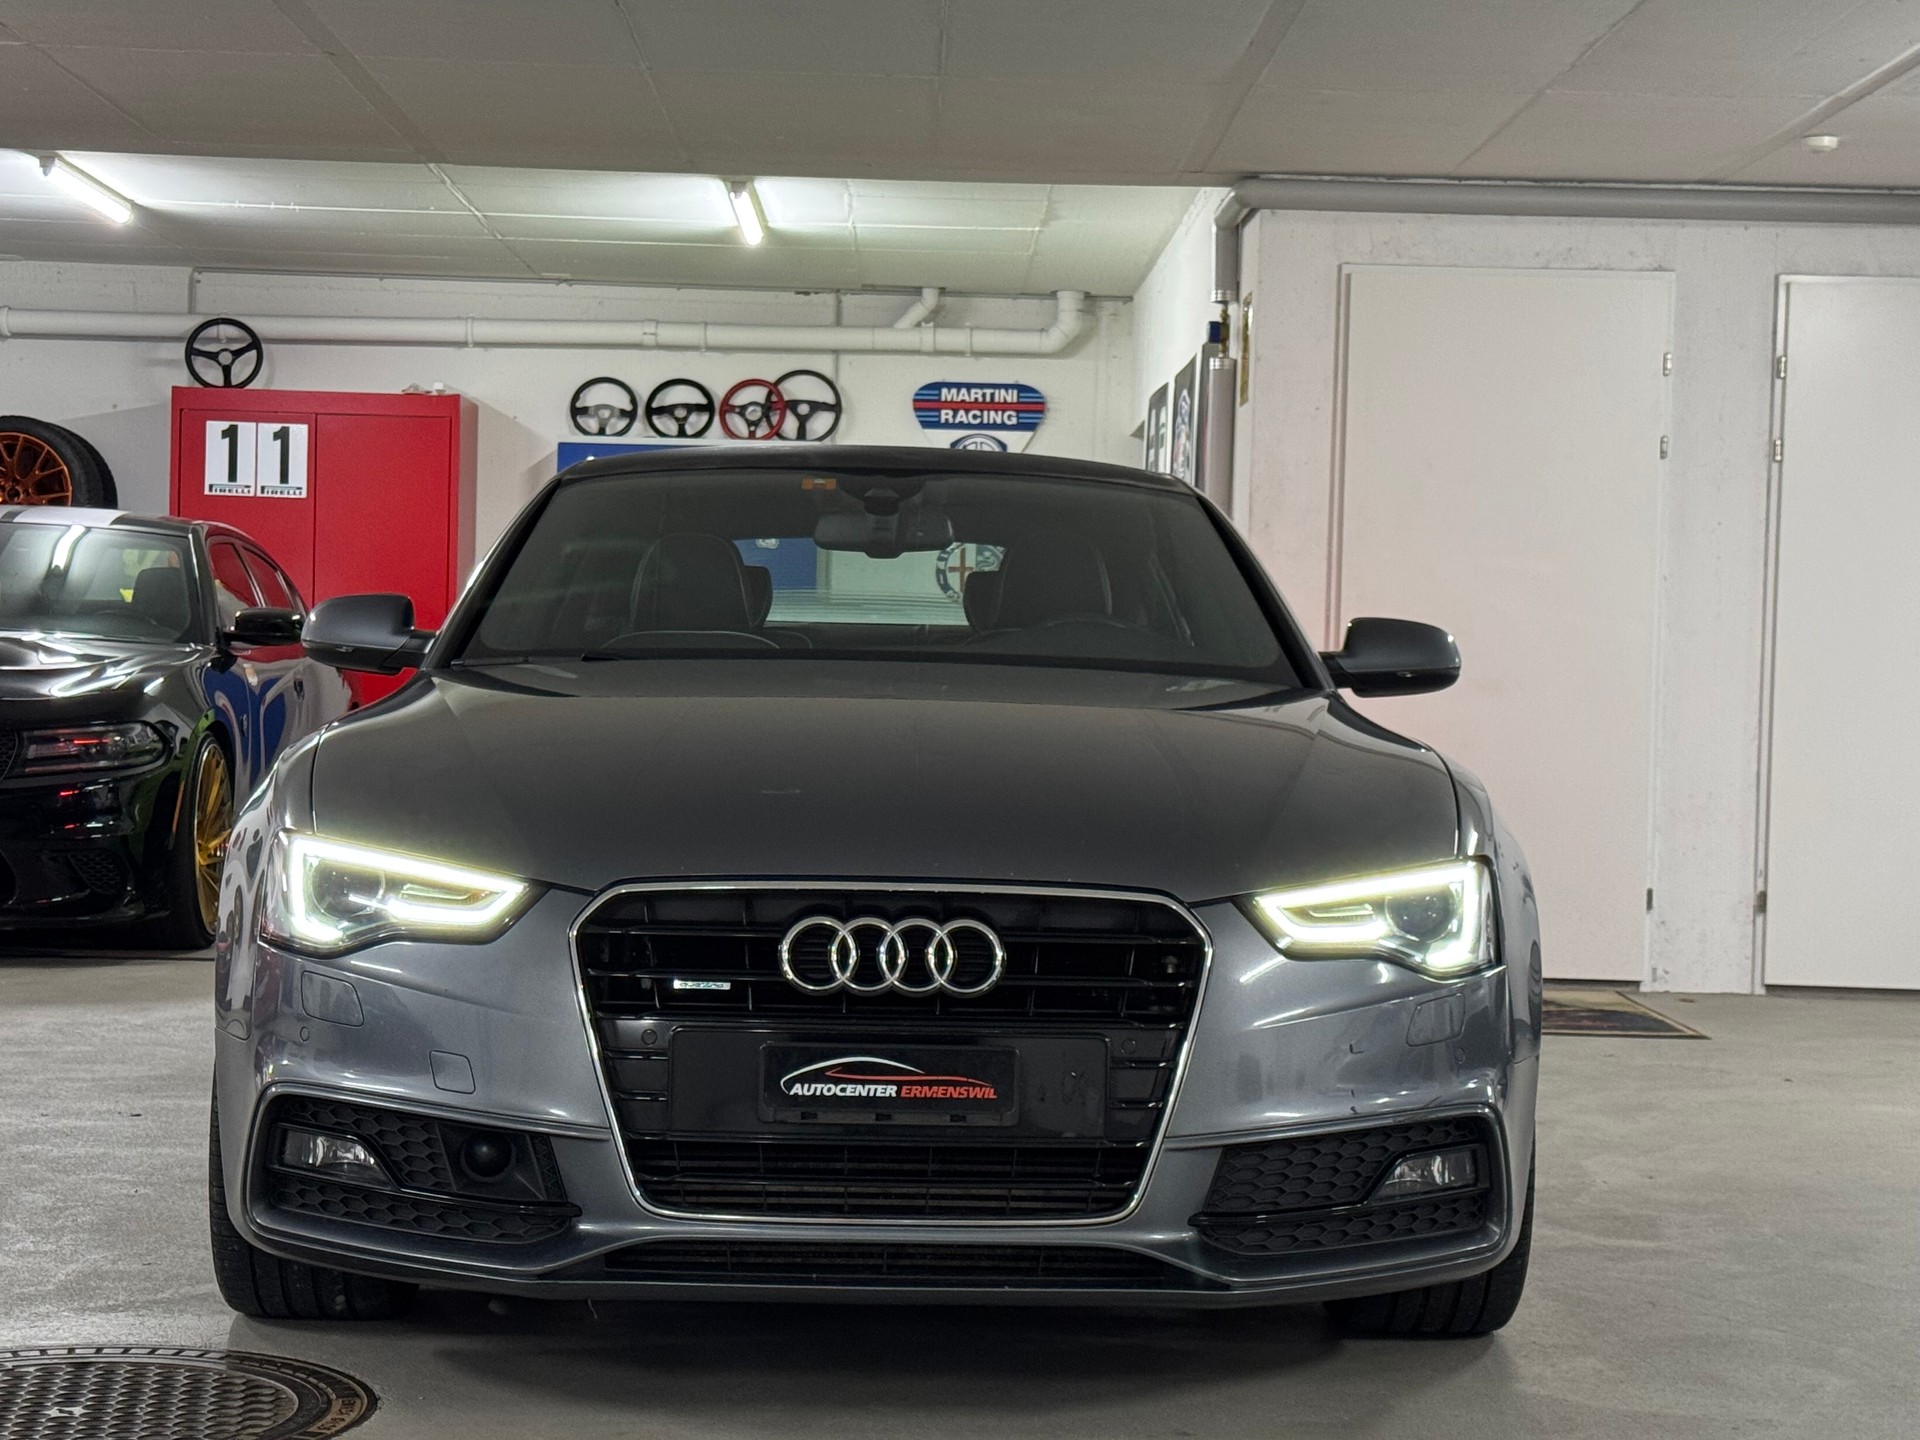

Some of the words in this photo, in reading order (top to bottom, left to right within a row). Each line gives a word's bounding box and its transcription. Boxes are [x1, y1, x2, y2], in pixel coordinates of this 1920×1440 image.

[940, 388, 1018, 403] MARTINI
[940, 409, 1018, 425] RACING
[208, 484, 251, 495] PIRELLI
[260, 485, 303, 497] PIRELLI
[789, 1083, 897, 1097] AUTOCENTER
[900, 1085, 998, 1099] ERMENSWIL
